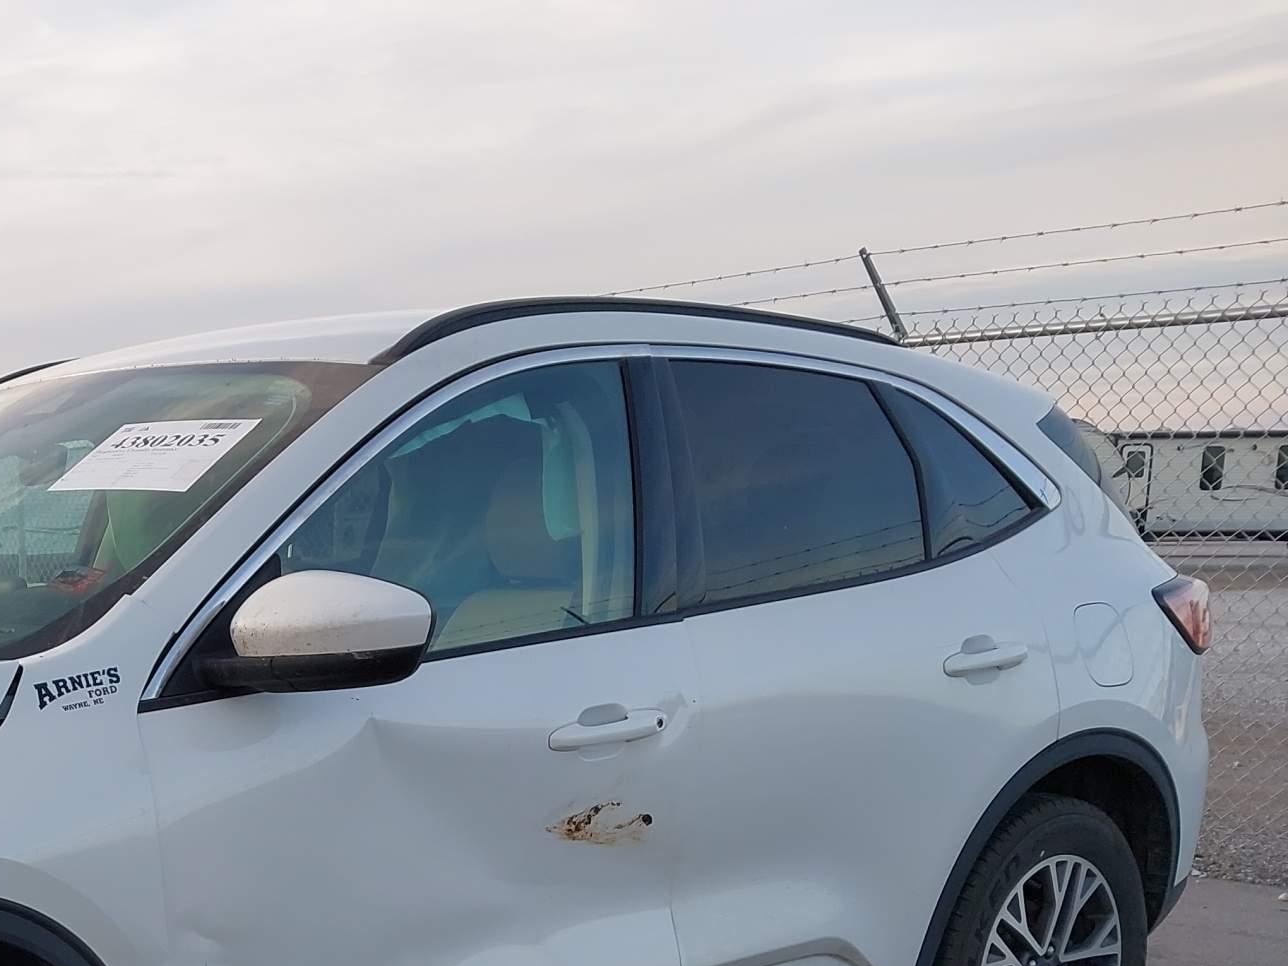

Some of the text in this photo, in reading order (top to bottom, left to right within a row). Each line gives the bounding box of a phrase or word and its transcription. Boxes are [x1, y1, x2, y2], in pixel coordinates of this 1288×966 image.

[110, 433, 225, 450] 43802035
[33, 666, 121, 711] ARNIE'S
[87, 685, 118, 699] FORD
[93, 698, 105, 706] NE
